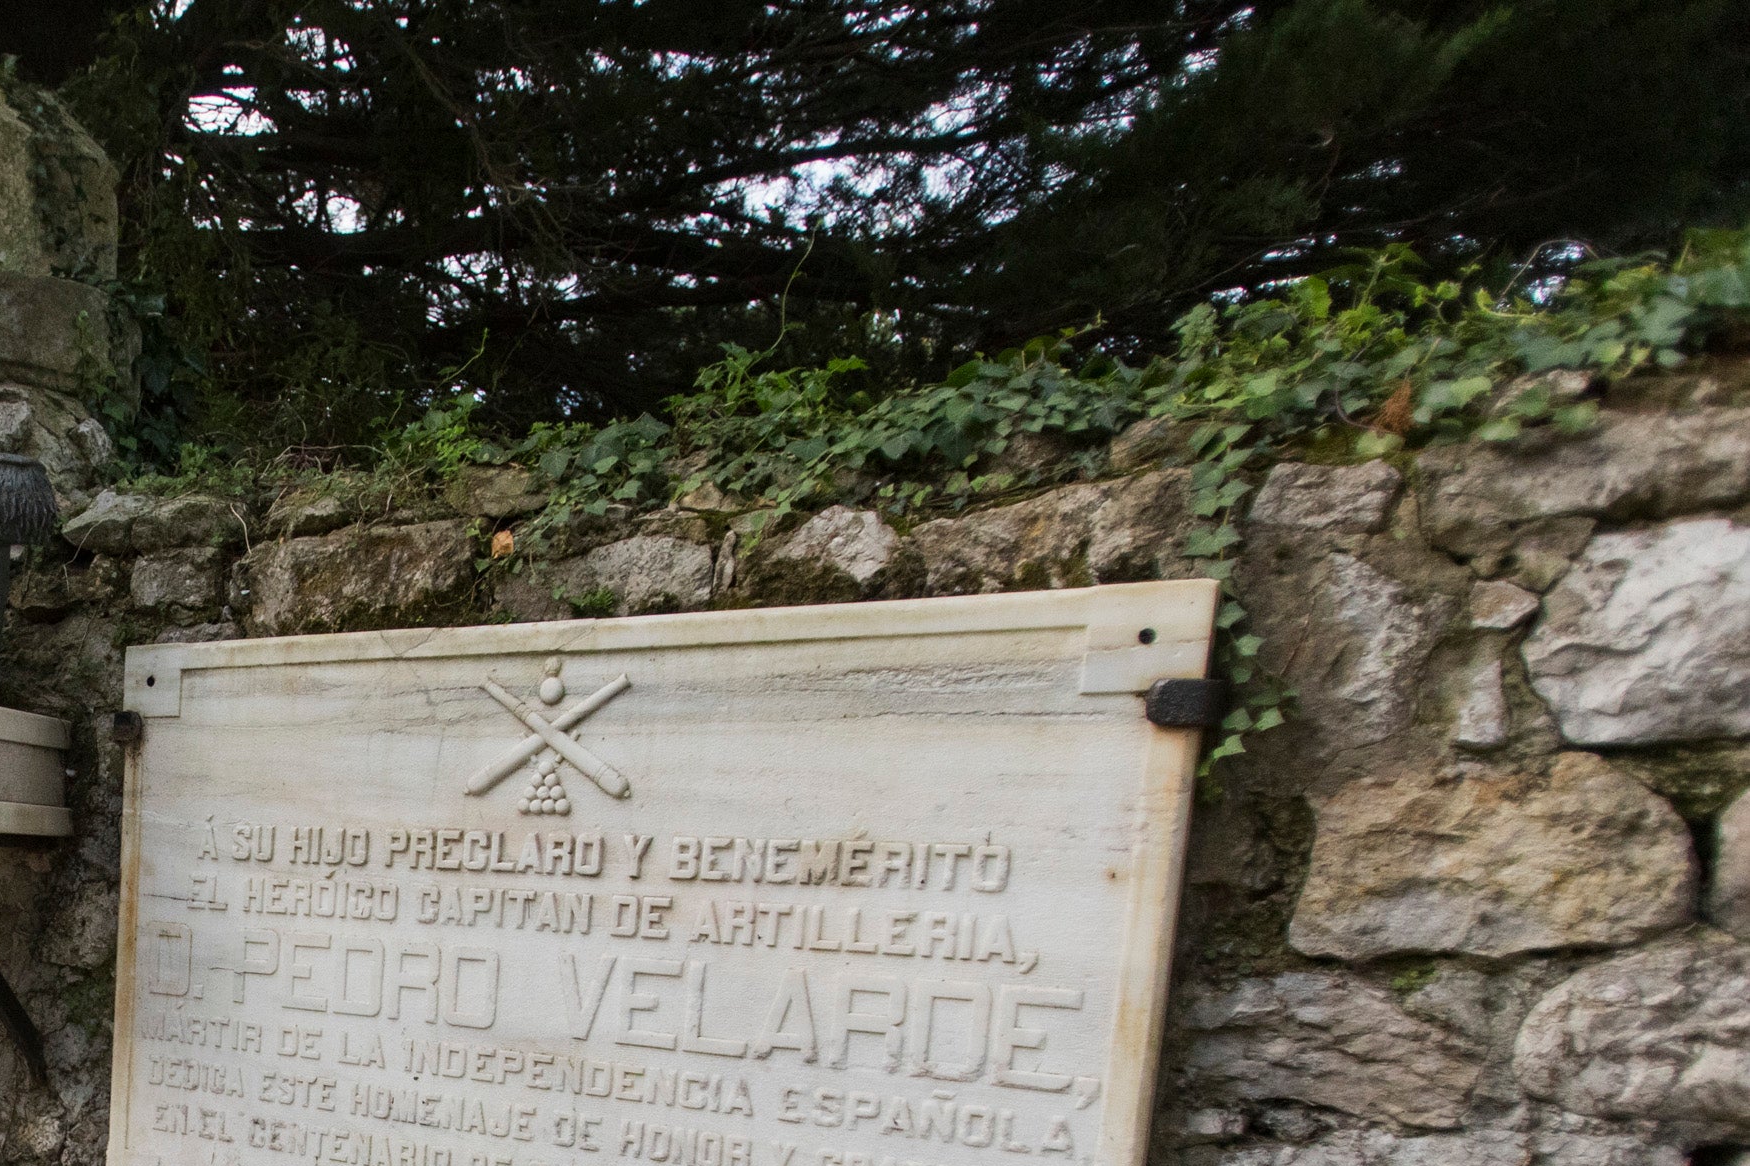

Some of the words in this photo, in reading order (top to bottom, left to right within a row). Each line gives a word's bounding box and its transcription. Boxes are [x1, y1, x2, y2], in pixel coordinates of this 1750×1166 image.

[231, 825, 276, 863] SU
[288, 827, 370, 867] HIJO
[384, 826, 604, 878] PRECLARO
[624, 833, 654, 880] Y
[187, 872, 228, 911] EL
[243, 870, 400, 922] HERÓICO
[415, 883, 595, 935] CAPITAN
[609, 894, 673, 940] DE
[146, 920, 204, 1001] D.
[232, 928, 500, 1030] PEDRO
[559, 953, 1100, 1110] VELARDE,
[148, 1055, 245, 1098] DEDICA
[259, 1072, 338, 1112] ESTE
[350, 1080, 540, 1142] HOMENAJE
[552, 1109, 610, 1154] DE
[277, 1026, 323, 1061] DE
[338, 1032, 386, 1070] LA
[402, 1038, 754, 1117] INDEPENDENCIA
[198, 1107, 235, 1144] EL
